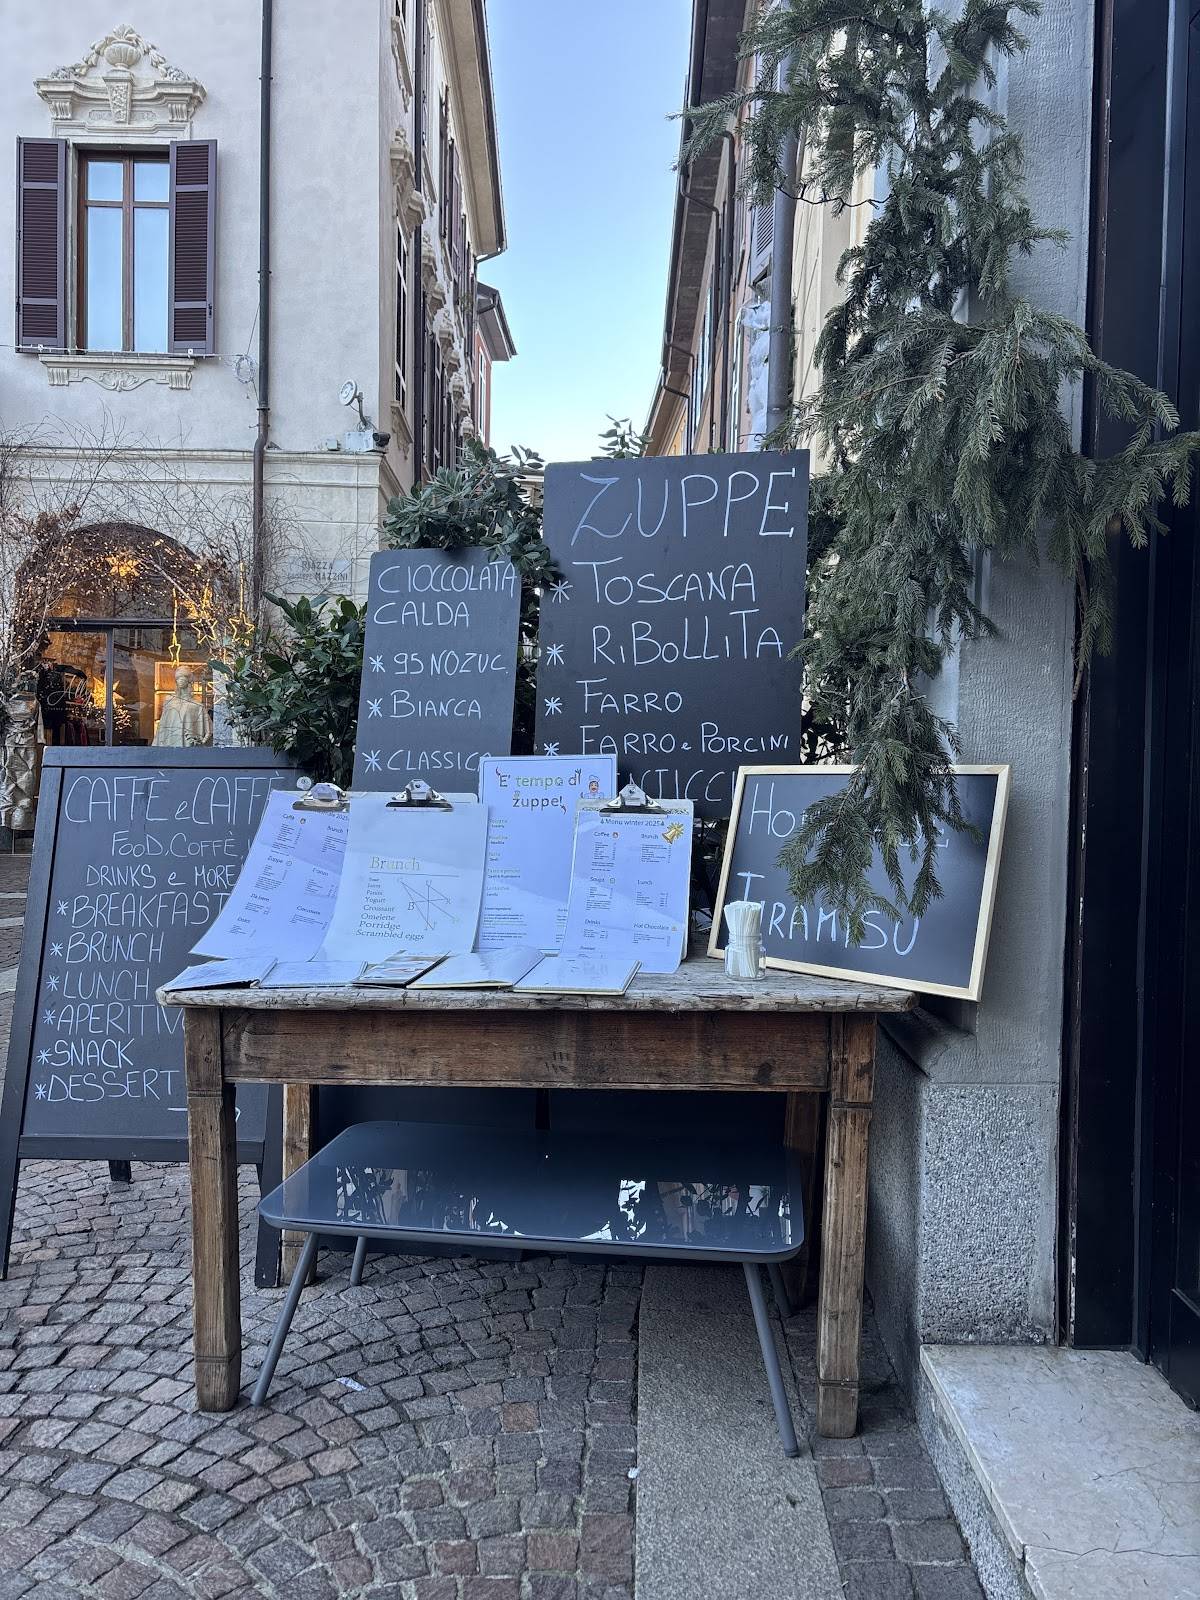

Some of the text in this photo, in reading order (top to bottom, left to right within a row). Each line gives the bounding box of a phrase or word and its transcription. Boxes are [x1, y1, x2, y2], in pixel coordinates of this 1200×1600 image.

[571, 467, 796, 546] ZUPPE
[377, 561, 518, 598] CIOCCOLATA
[572, 557, 756, 606] TOSCANA
[373, 601, 470, 628] CALDA
[389, 689, 482, 720] BIANCA
[575, 677, 683, 714] FARRO
[579, 724, 676, 756] FARRO
[701, 721, 790, 754] PORCINI
[65, 770, 170, 823] CAFFÈ
[174, 800, 191, 821] e
[515, 776, 564, 790] tempo
[568, 772, 581, 787] di
[623, 819, 644, 827] winter
[86, 863, 157, 889] DRINKS
[168, 871, 186, 886] e
[368, 856, 421, 871] Brunch
[71, 891, 231, 929] BREAKFAST
[365, 896, 387, 905] Yogurt
[355, 929, 425, 942] Scrambled eggs
[359, 920, 401, 930] Porridge
[66, 930, 165, 963] BRUNCH
[63, 968, 150, 1001] LUNCH
[57, 1001, 185, 1037] APERITIV
[50, 1038, 135, 1069] SNACK
[47, 1068, 181, 1102] DESSERT
